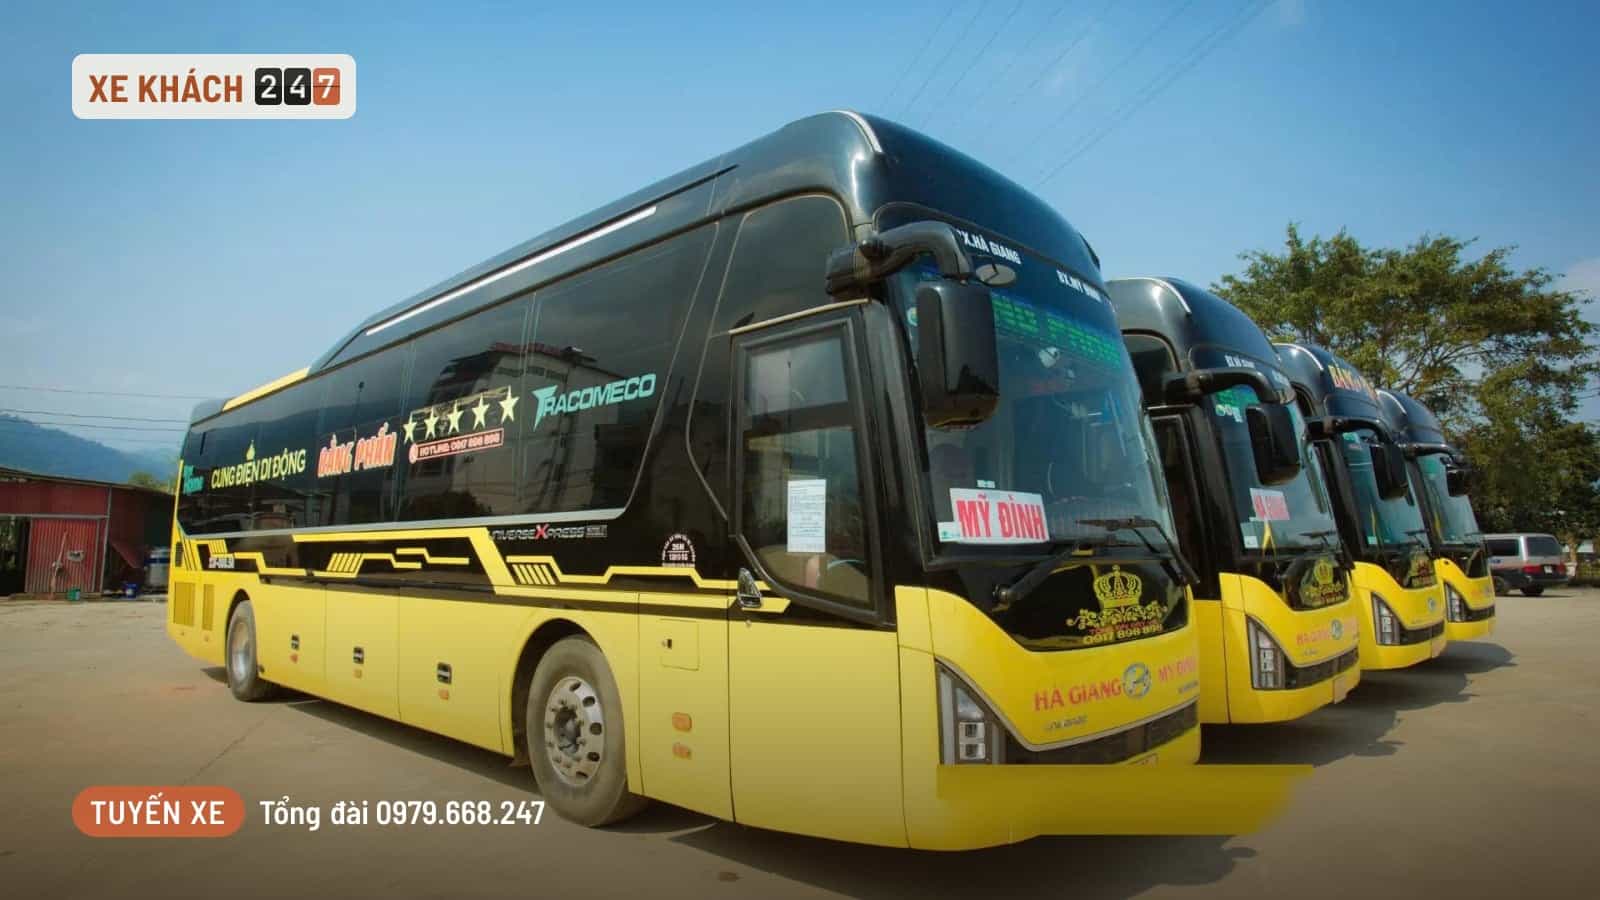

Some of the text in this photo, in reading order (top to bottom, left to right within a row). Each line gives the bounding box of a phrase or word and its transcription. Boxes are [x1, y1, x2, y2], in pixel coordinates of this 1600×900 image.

[532, 373, 656, 432] TRACOMECO
[211, 465, 236, 489] CUNG
[235, 459, 260, 487] ĐIỆN
[260, 457, 272, 481] DI
[272, 448, 306, 480] ĐỘNG
[956, 492, 1046, 540] MỸ ĐÌNH
[1068, 677, 1122, 705] GIANG
